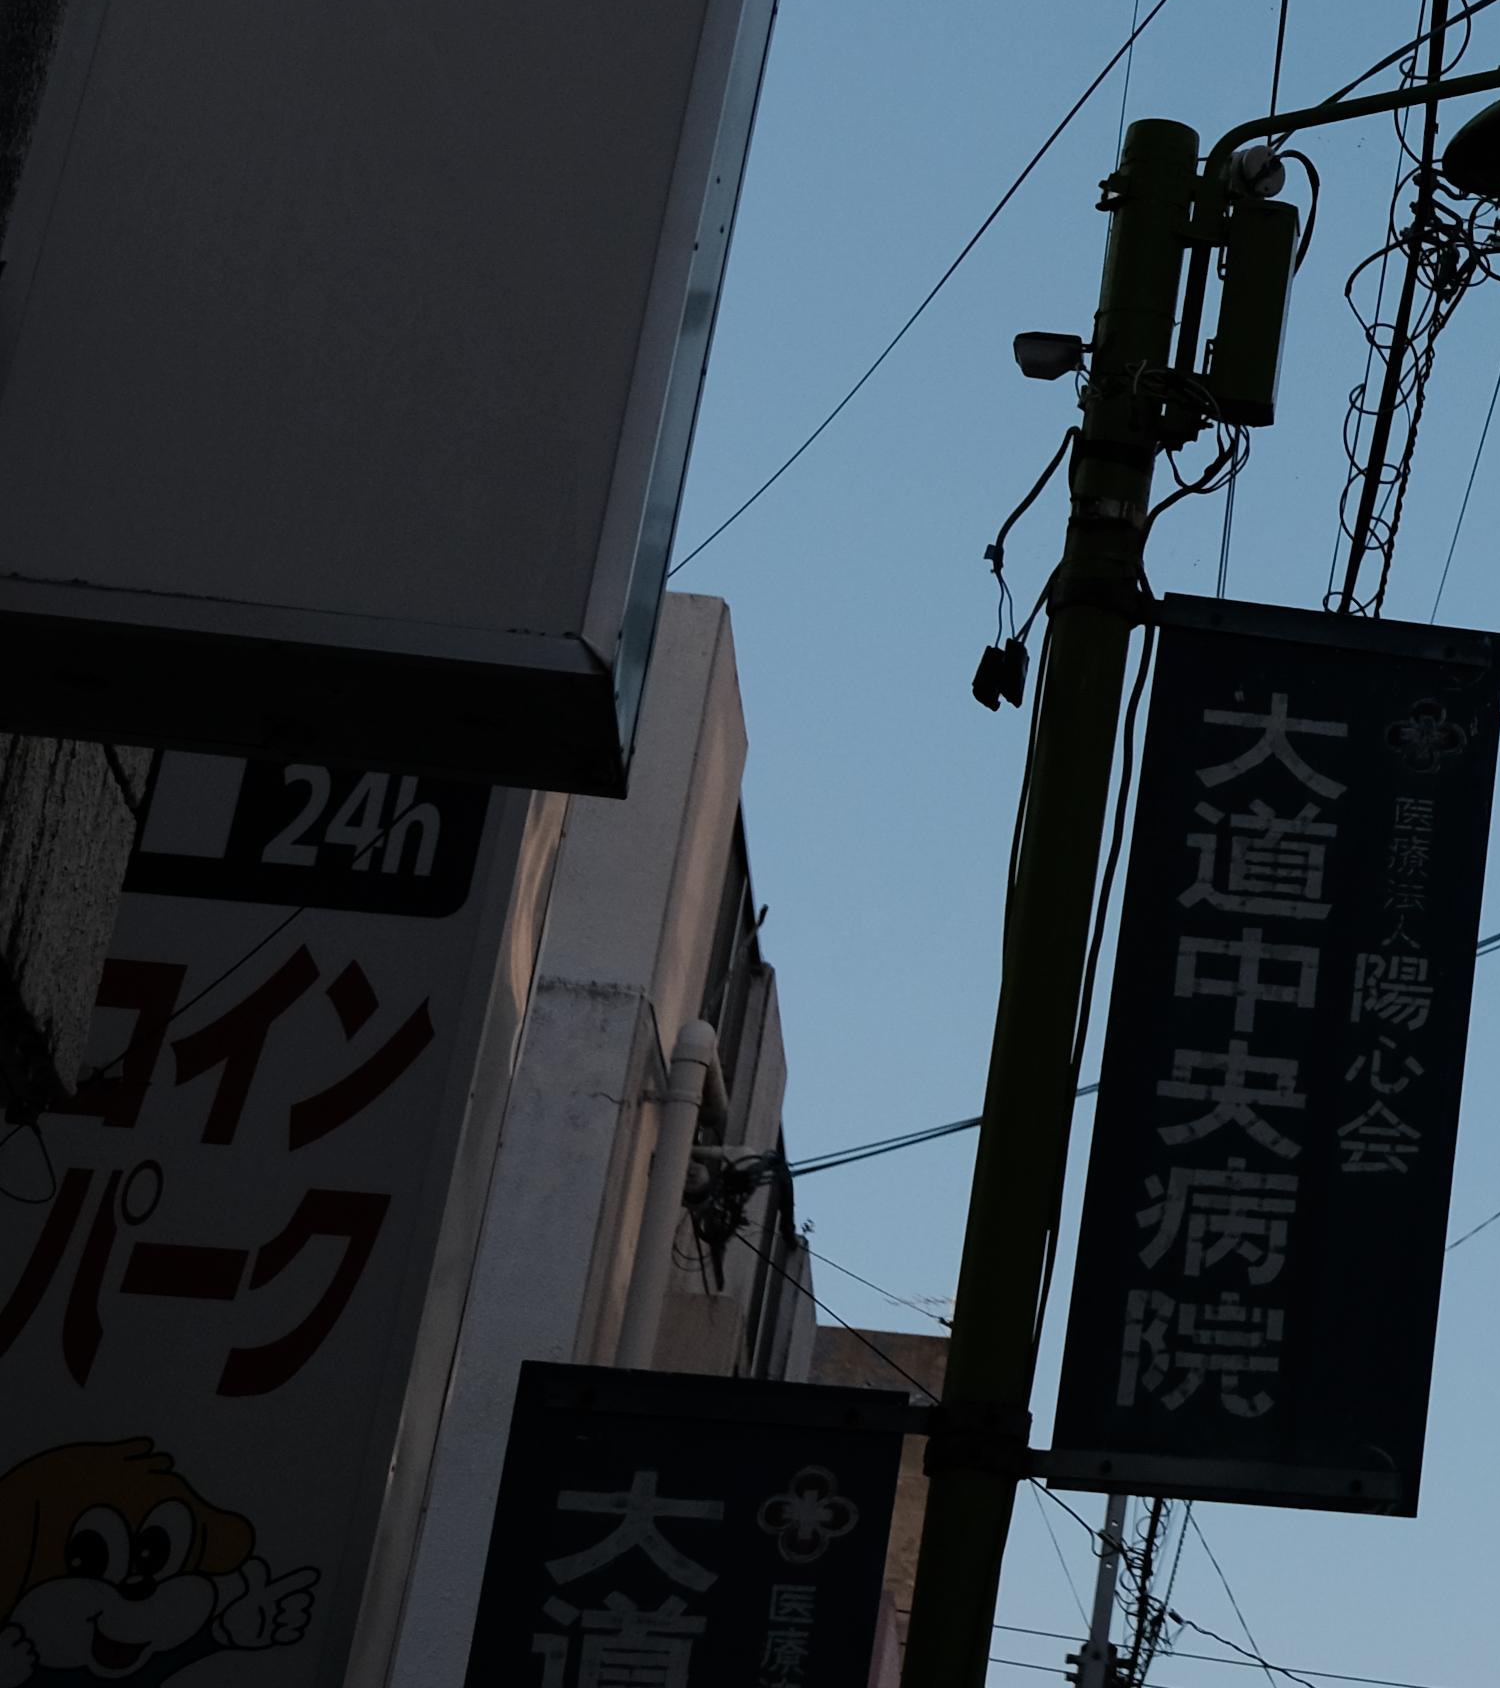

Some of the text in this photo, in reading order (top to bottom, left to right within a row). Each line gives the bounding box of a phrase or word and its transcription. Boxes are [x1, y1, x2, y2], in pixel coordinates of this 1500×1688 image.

[261, 763, 443, 876] 24h
[1116, 692, 1350, 1419] 大道中央病院
[0, 1160, 392, 1397] パーク
[759, 1584, 817, 1688] 医療
